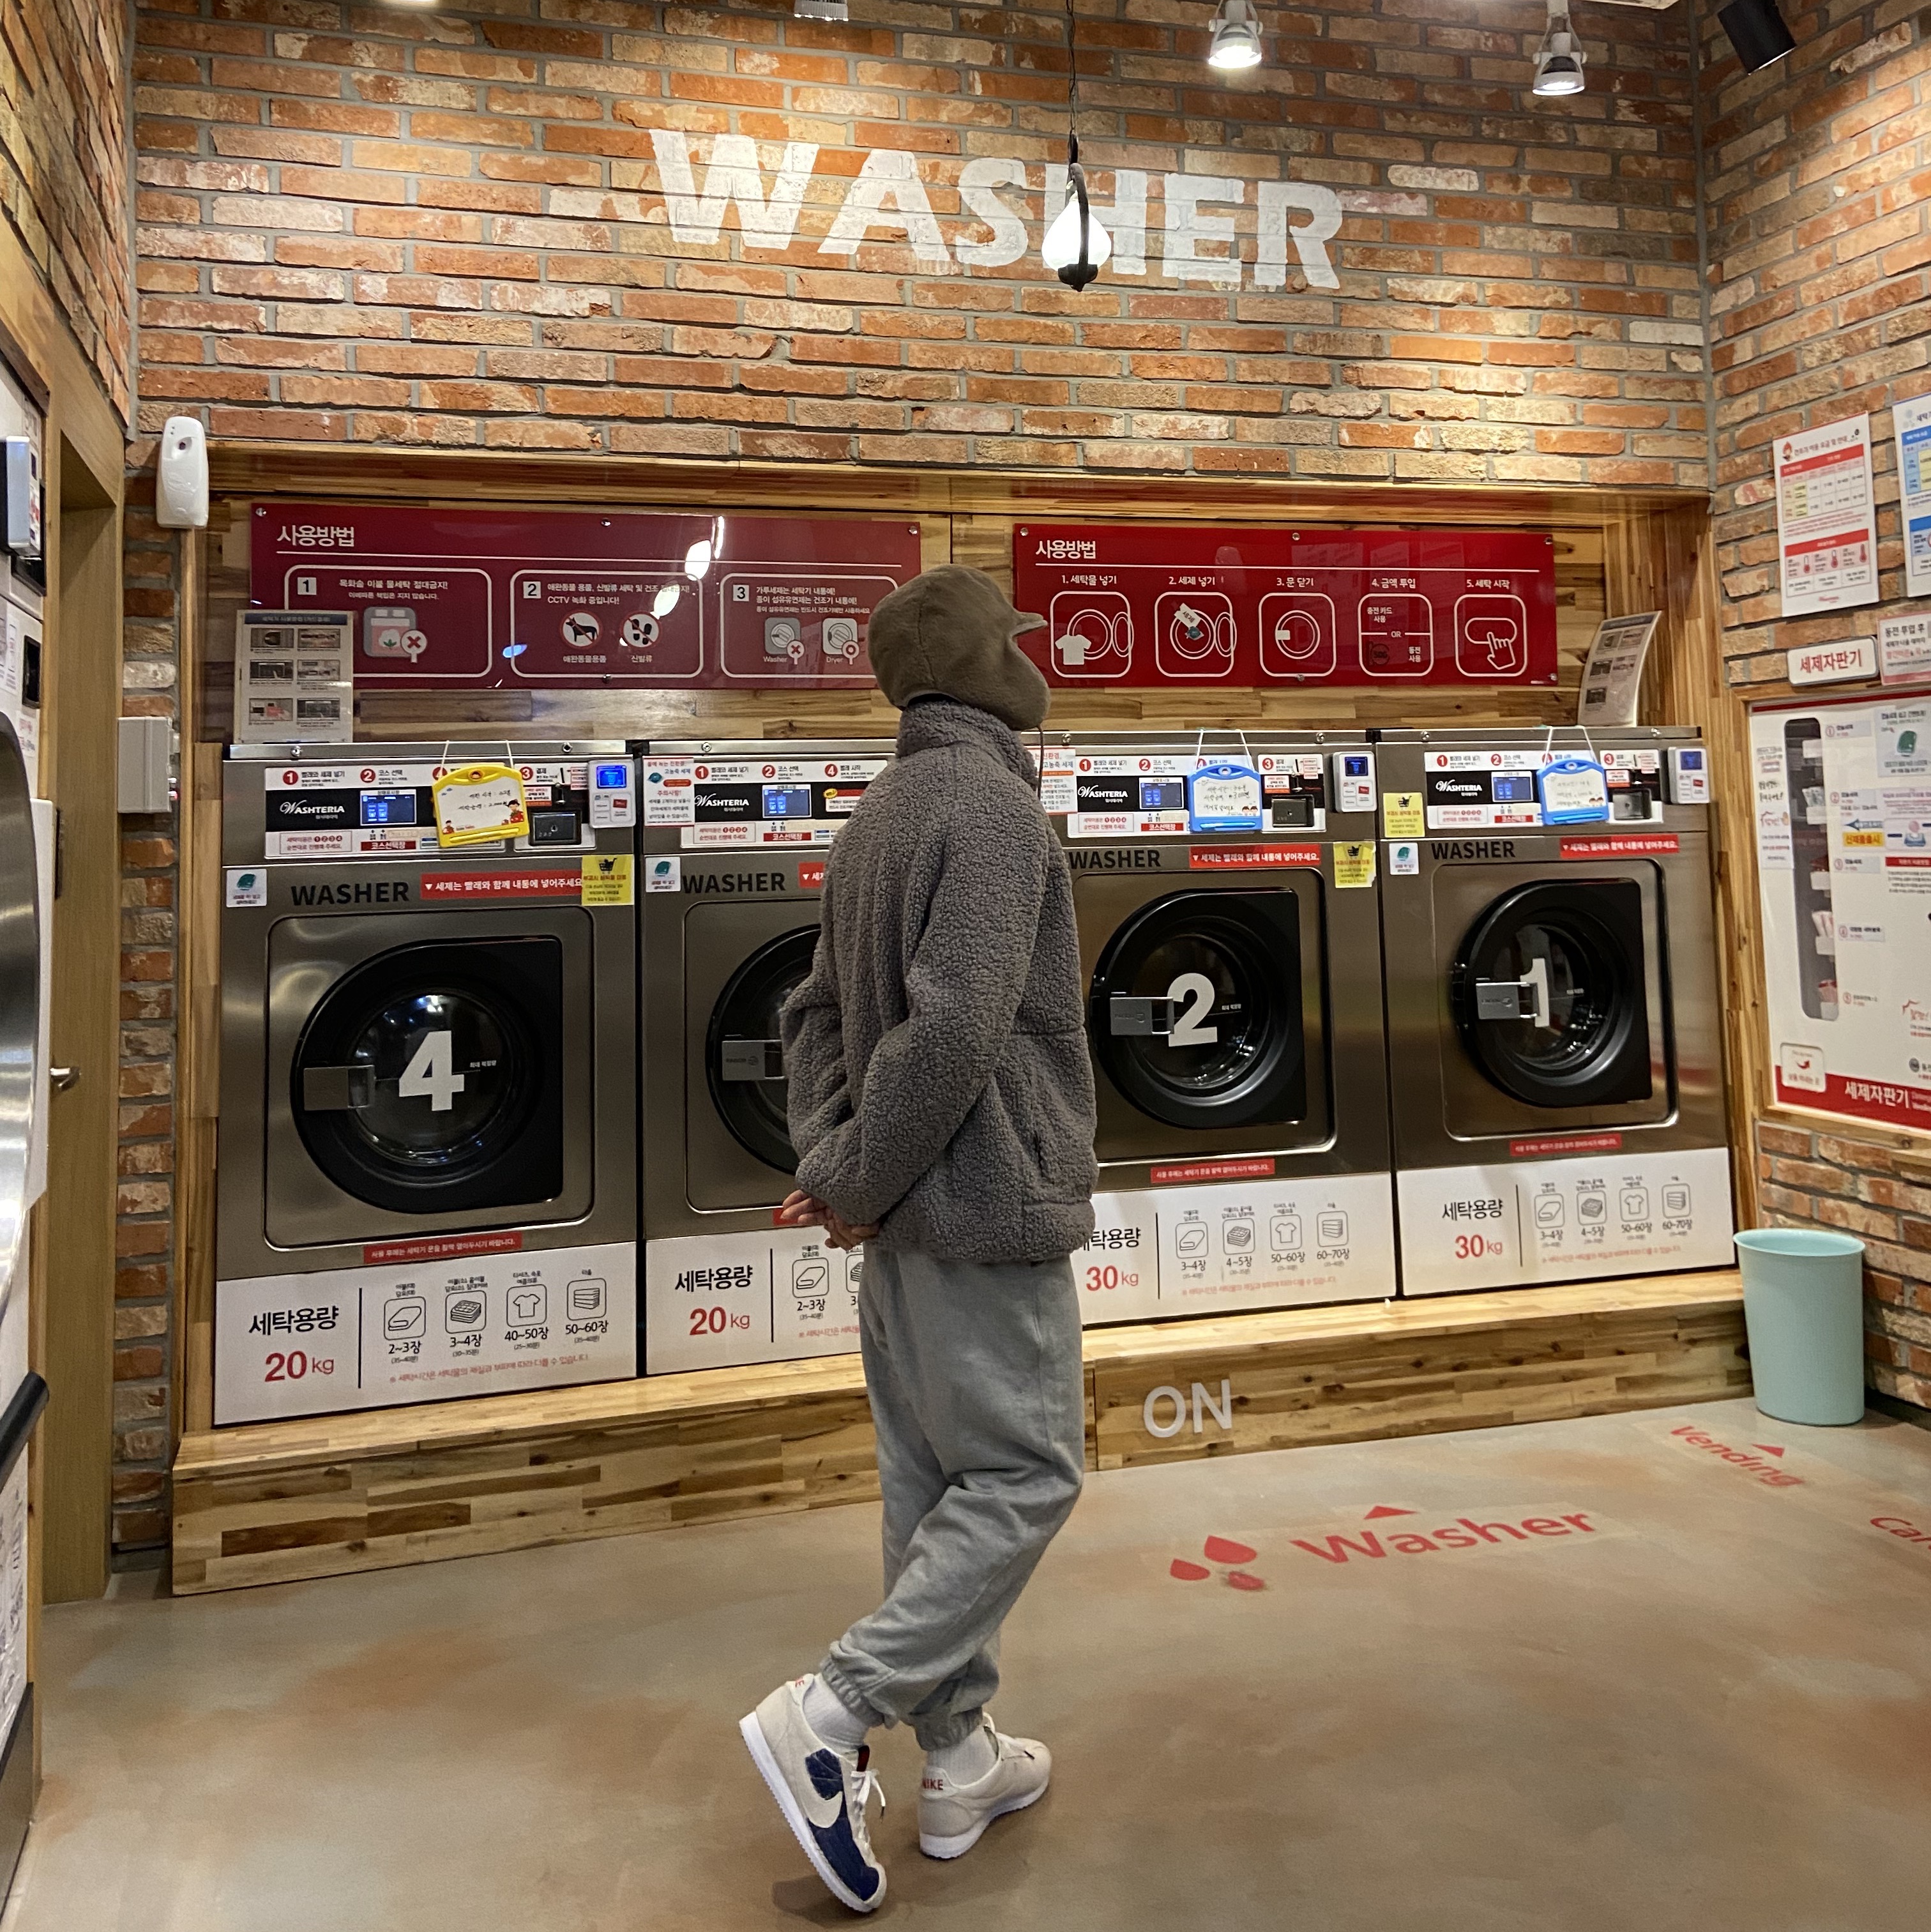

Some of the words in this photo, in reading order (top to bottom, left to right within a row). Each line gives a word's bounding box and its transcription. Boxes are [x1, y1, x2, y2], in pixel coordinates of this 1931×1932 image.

[650, 128, 1342, 289] WASHER
[276, 525, 354, 547] 사용방법
[1036, 540, 1096, 559] 사용방법
[303, 579, 311, 593] 1
[367, 580, 383, 589] 이불
[414, 581, 448, 589] 절대금지!
[1070, 575, 1097, 585] 세탁물
[1099, 575, 1117, 585] 넣기
[1178, 576, 1196, 586] 세제
[1198, 577, 1215, 586] 넣기
[1285, 578, 1295, 588] 문
[1297, 578, 1314, 588] 닫기
[1382, 579, 1398, 588] 금액
[1399, 579, 1416, 589] 투입
[1475, 579, 1492, 589] 세탁
[1494, 580, 1510, 589] 시작
[527, 583, 537, 597] 2
[547, 583, 576, 591] 애완동물
[596, 584, 617, 592] 신발류
[619, 584, 633, 592] 세탁
[736, 586, 746, 599] 3
[1800, 649, 1863, 674] 세제자판기
[1078, 785, 1128, 798] WASHTERIA
[1435, 779, 1482, 792] WASHTERIA
[280, 800, 345, 814] WASHTERIA
[695, 793, 750, 807] WASHTERIA
[1431, 841, 1515, 860] WASHER
[1068, 849, 1161, 870] WASHER
[436, 881, 462, 891] 세제는
[464, 881, 490, 890] 빨래와
[493, 880, 510, 889] 함께
[513, 879, 538, 888] 내통에
[683, 872, 785, 894] WASHER
[291, 882, 409, 906] WASHER
[1520, 958, 1549, 1028] 1
[1167, 973, 1218, 1047] 2
[399, 1030, 464, 1111] 4
[1845, 1081, 1910, 1109] 세제자판기
[1442, 1199, 1503, 1221] 세탁용량
[675, 1265, 753, 1293] 세탁용량
[797, 1298, 826, 1311] 2~3장
[249, 1305, 339, 1335] 세탁용량
[504, 1327, 549, 1341] 40~50장
[566, 1321, 609, 1334] 50~60장
[389, 1341, 421, 1354] 2~3장
[450, 1334, 482, 1348] 3~4장
[1143, 1379, 1232, 1438] ON
[1670, 1426, 1806, 1487] Vending
[1291, 1512, 1597, 1563] Washer
[921, 1778, 943, 1791] NIKE
